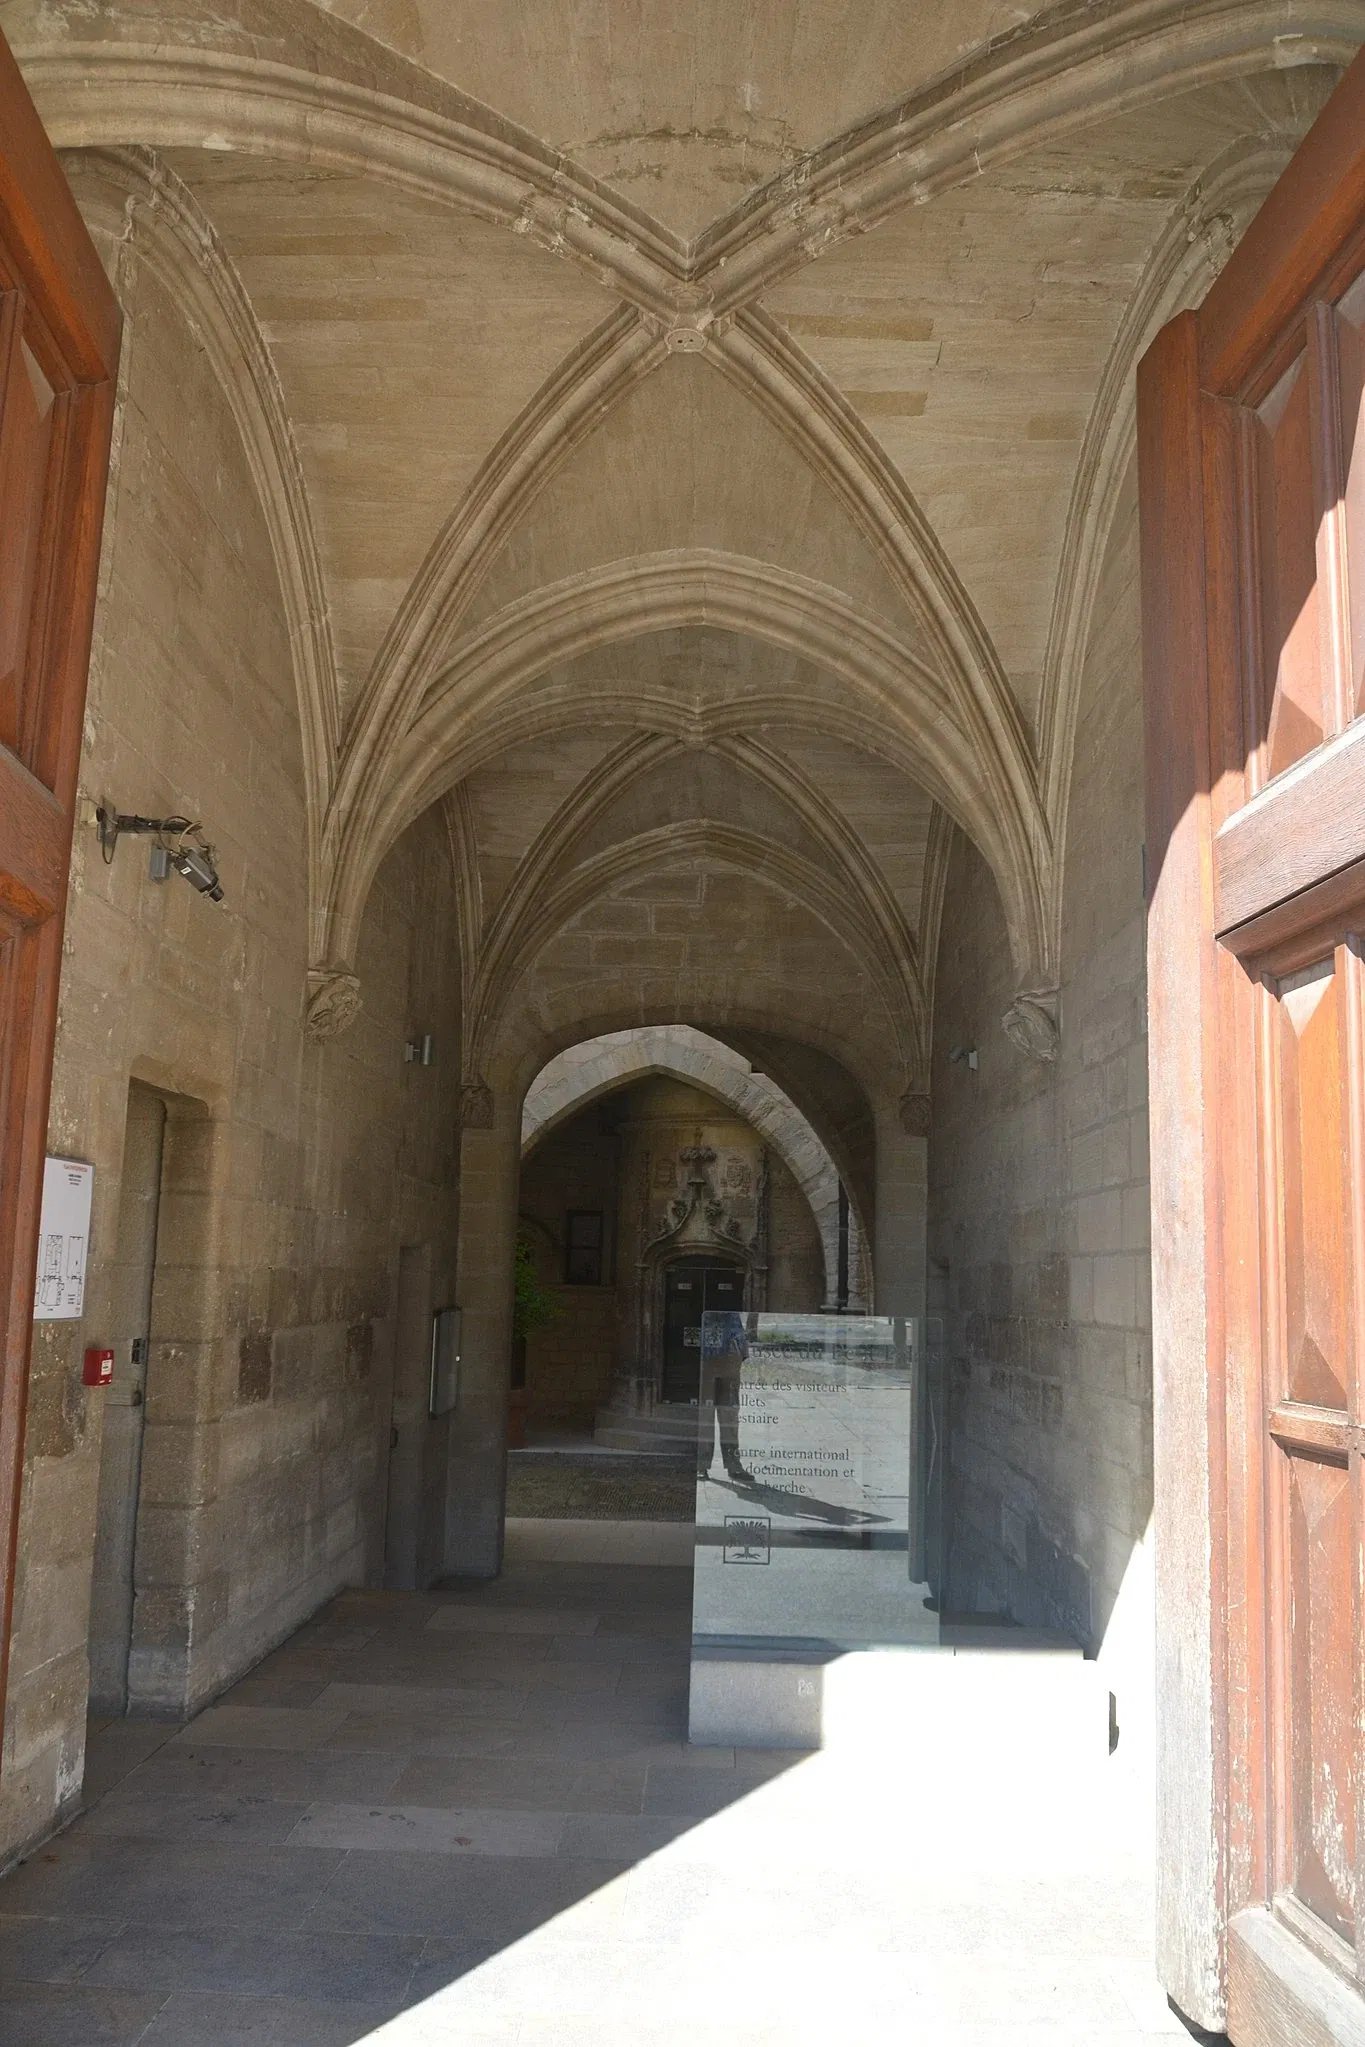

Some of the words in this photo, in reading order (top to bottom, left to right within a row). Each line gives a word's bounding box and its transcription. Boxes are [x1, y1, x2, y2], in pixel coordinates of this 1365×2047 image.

[772, 1379, 792, 1391] des
[795, 1379, 847, 1393] visiteurs
[740, 1394, 766, 1407] llets
[737, 1412, 779, 1425] estiaire
[769, 1445, 850, 1461] international
[745, 1462, 839, 1478] documentation
[843, 1467, 855, 1479] et
[763, 1479, 806, 1494] herche
